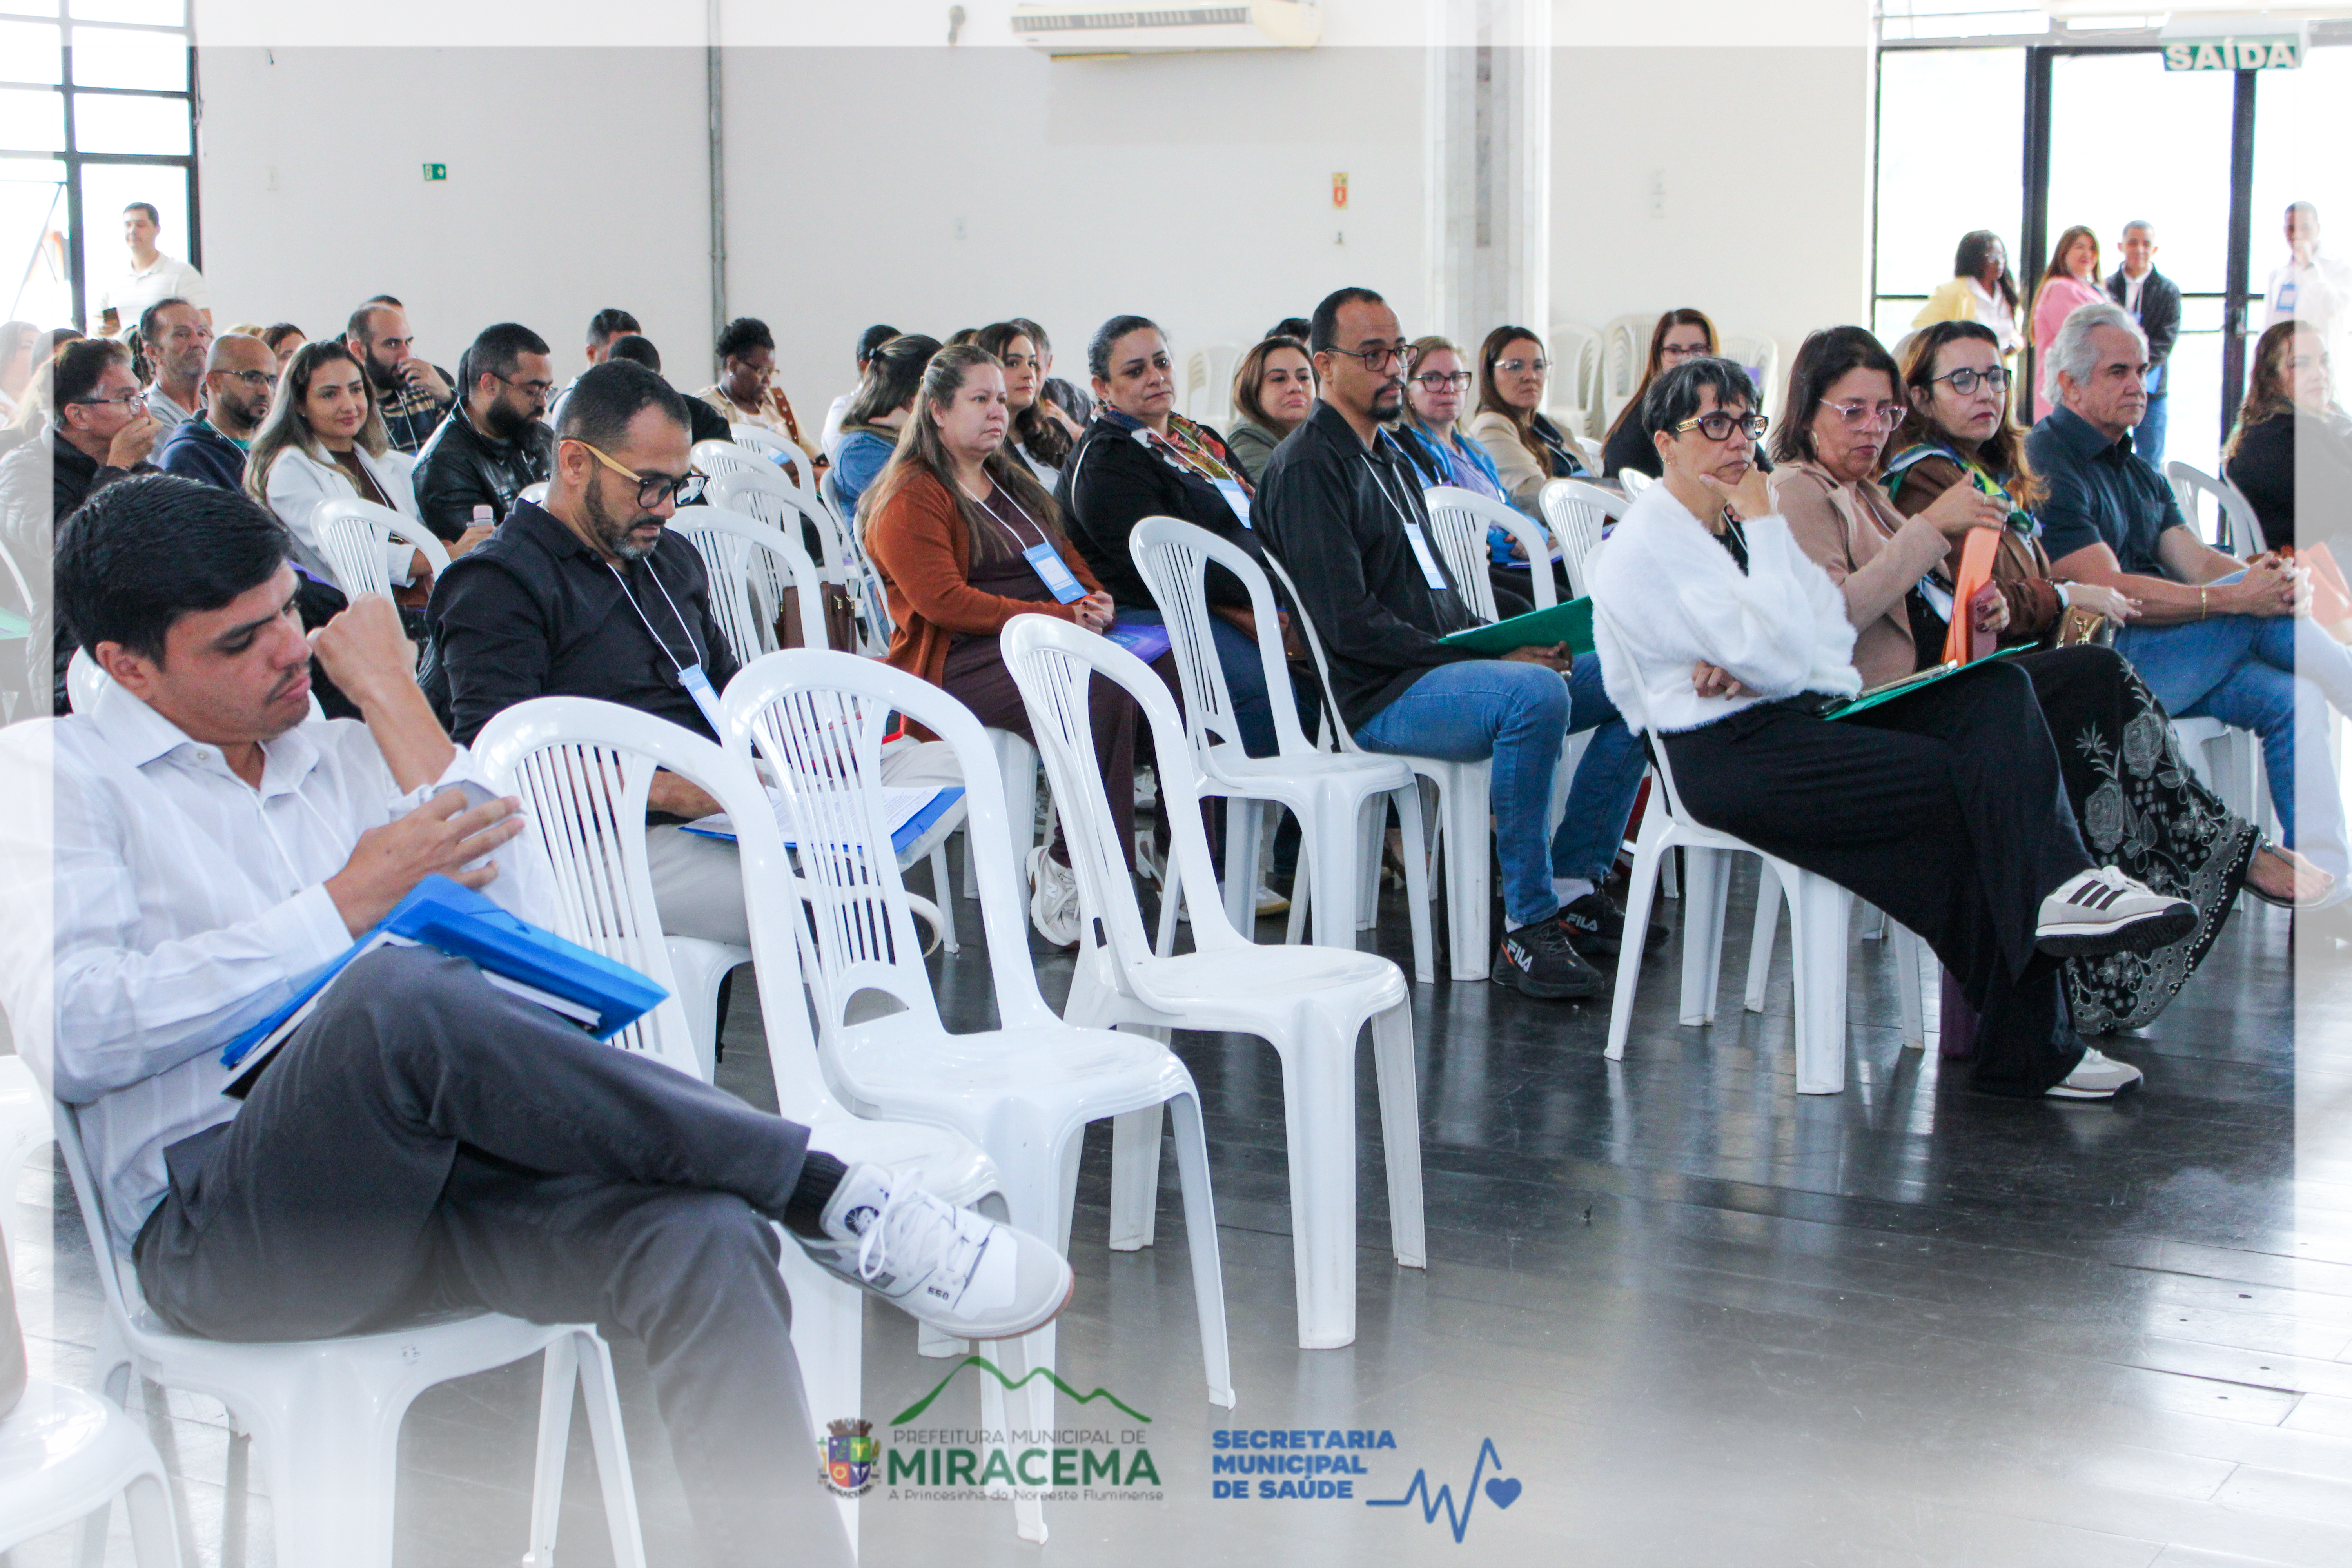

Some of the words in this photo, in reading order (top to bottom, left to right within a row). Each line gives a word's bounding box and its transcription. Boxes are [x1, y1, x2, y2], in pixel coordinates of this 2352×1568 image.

[2166, 37, 2296, 70] SAÍDA
[1566, 913, 1598, 932] FILA
[1507, 938, 1533, 973] FILA
